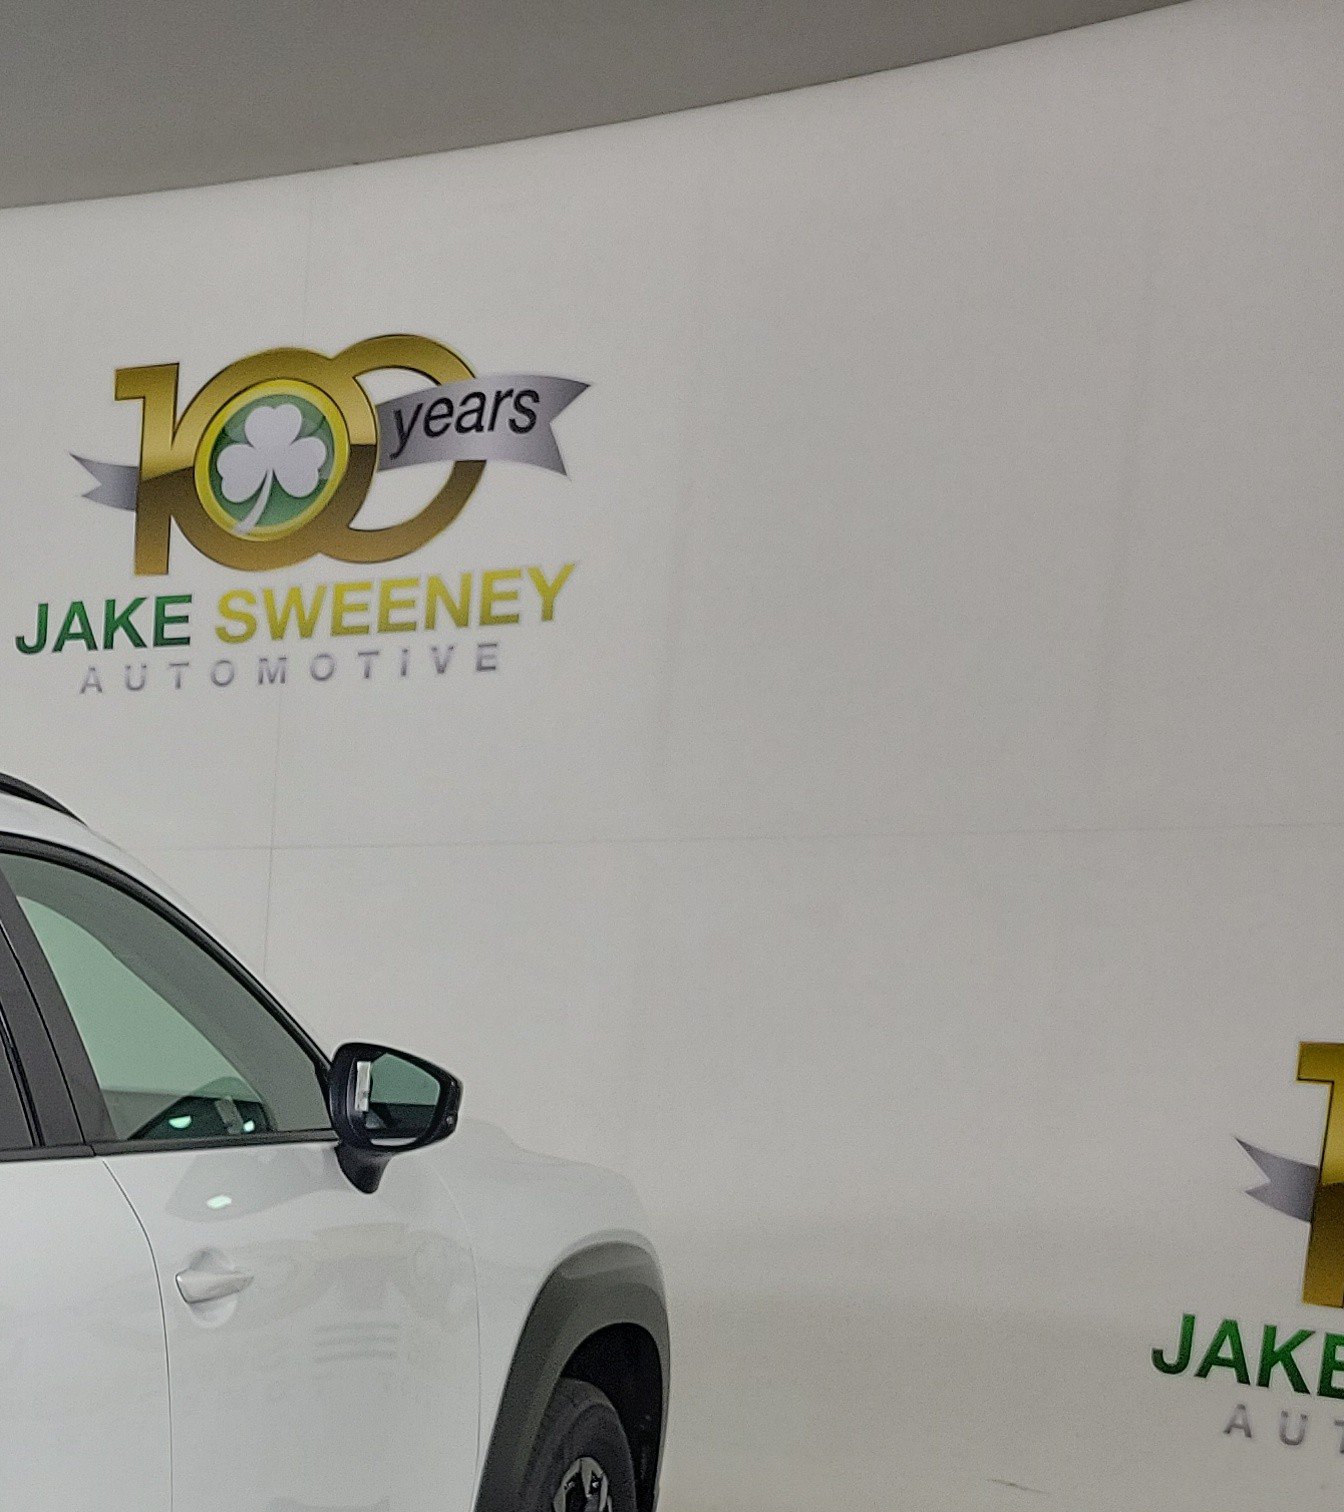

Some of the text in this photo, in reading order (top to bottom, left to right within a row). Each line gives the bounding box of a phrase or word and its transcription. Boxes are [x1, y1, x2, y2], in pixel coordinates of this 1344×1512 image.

[114, 333, 540, 576] 100 years
[15, 562, 576, 655] JAKE SWEENEY
[79, 642, 500, 695] AUTOMOTIVE
